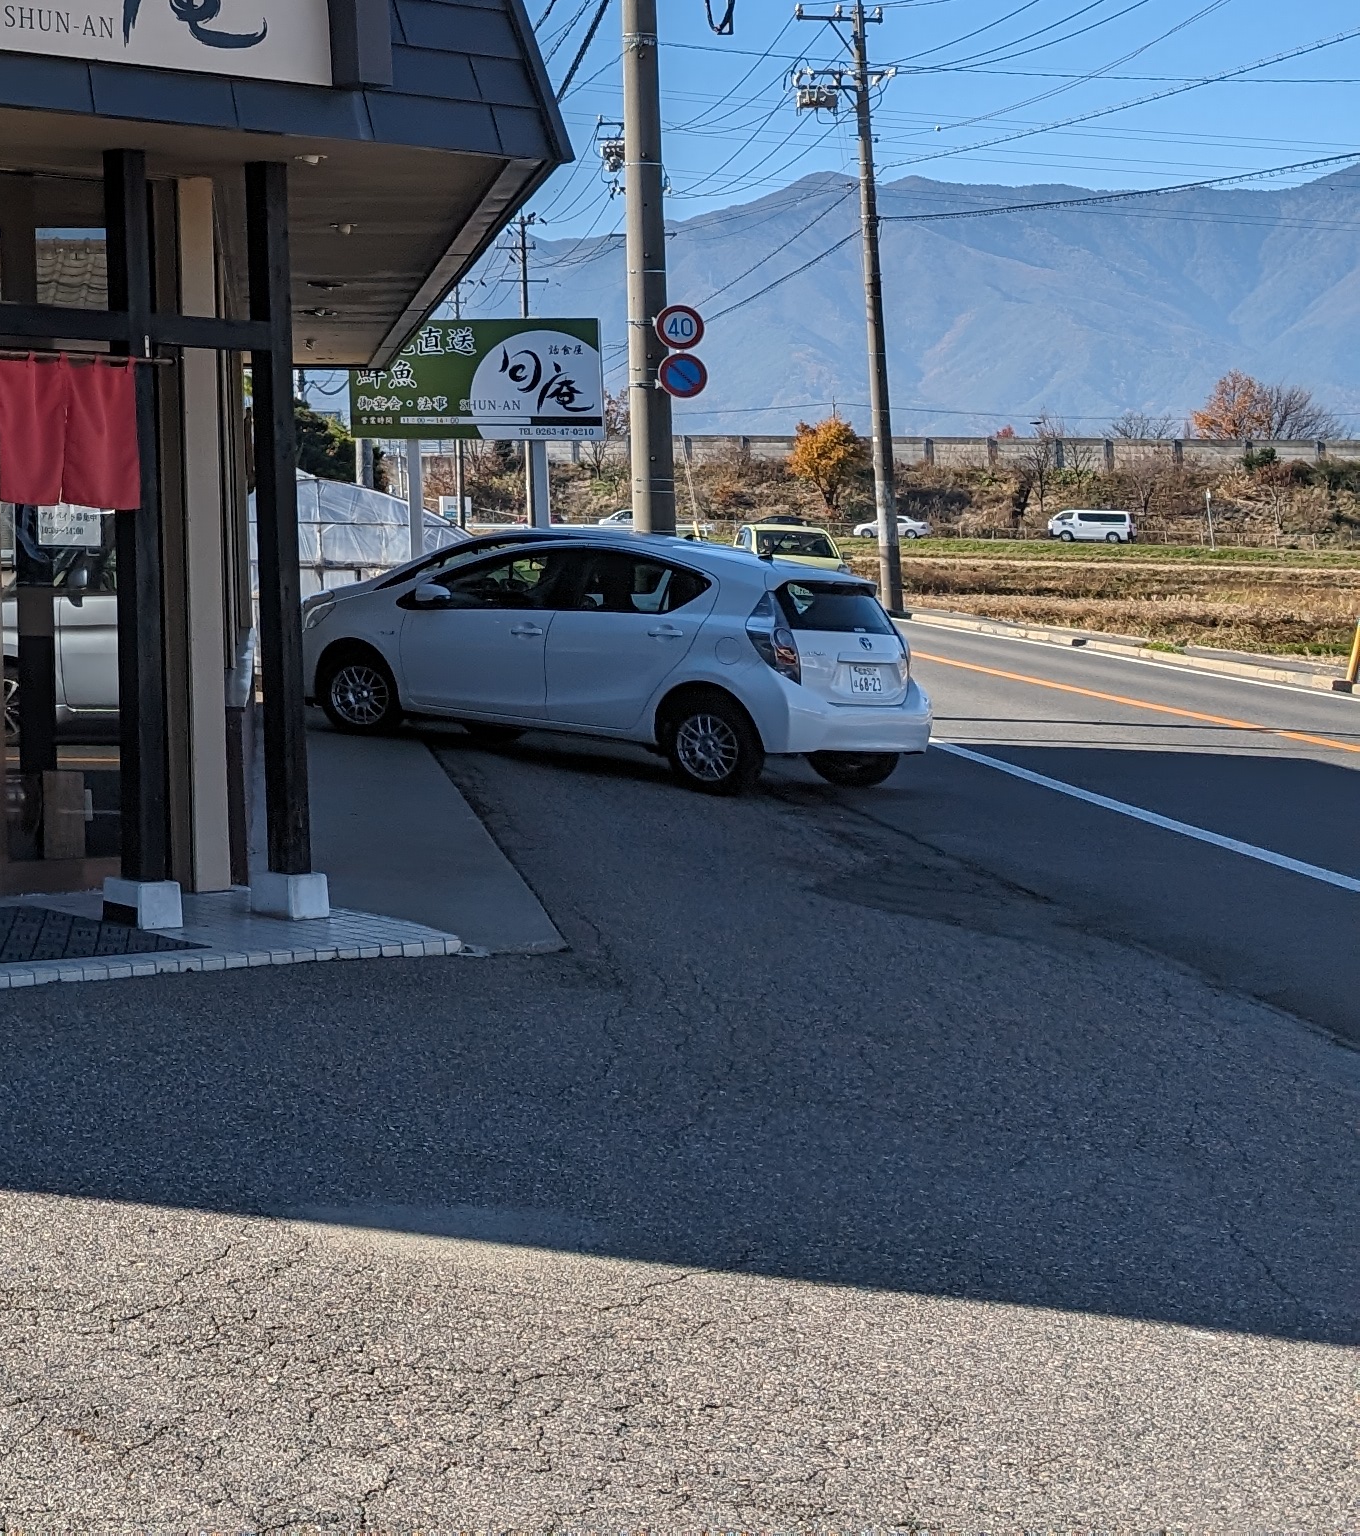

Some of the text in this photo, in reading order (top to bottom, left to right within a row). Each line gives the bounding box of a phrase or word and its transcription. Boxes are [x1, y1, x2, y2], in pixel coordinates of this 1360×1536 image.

[3, 5, 115, 40] SHUN-AN
[667, 317, 693, 337] 40
[400, 325, 477, 356] 直送
[459, 399, 521, 411] SHUN-AN
[519, 427, 533, 436] TEL
[859, 677, 882, 691] 68-23
